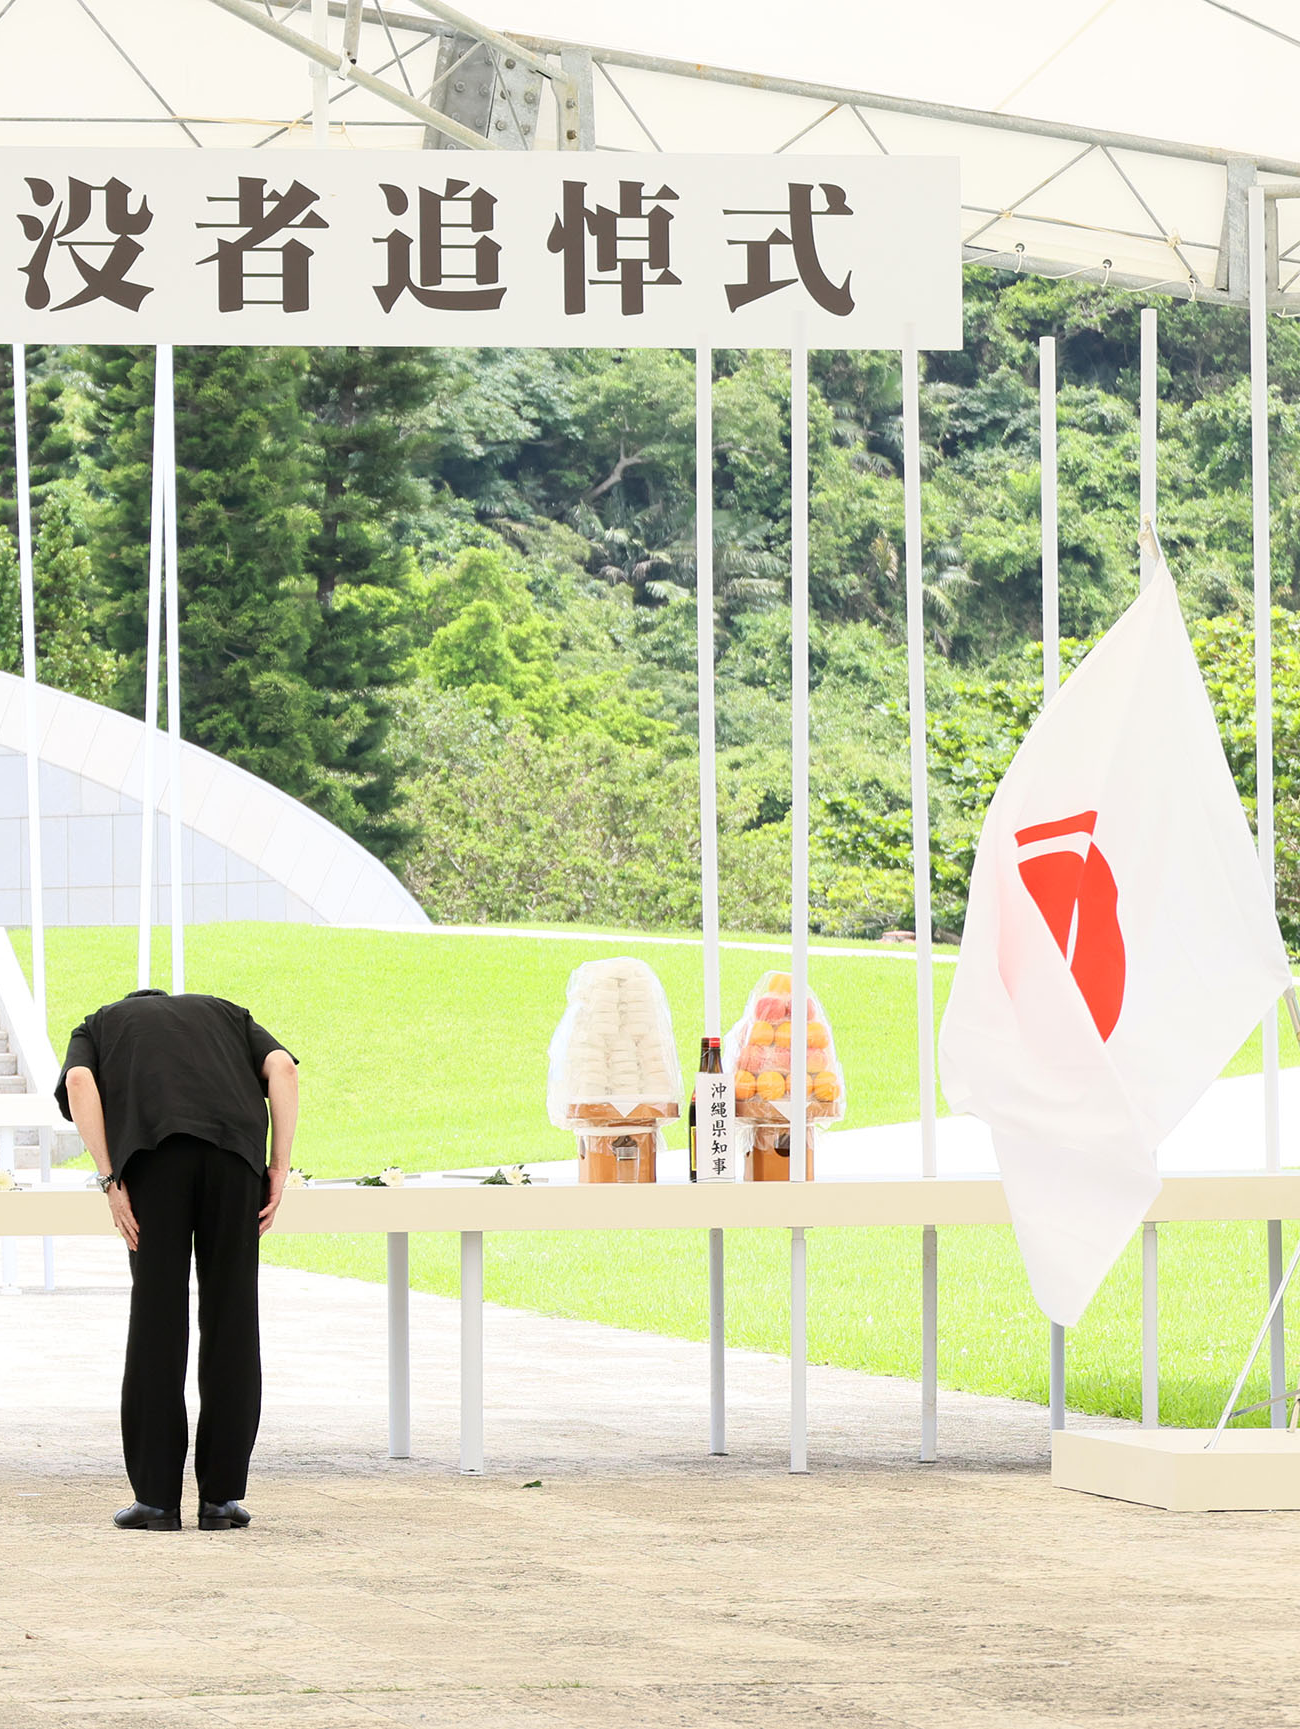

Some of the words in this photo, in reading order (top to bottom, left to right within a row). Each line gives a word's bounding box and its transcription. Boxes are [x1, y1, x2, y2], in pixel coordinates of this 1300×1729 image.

[710, 1082, 728, 1176] 沖縄県知事
